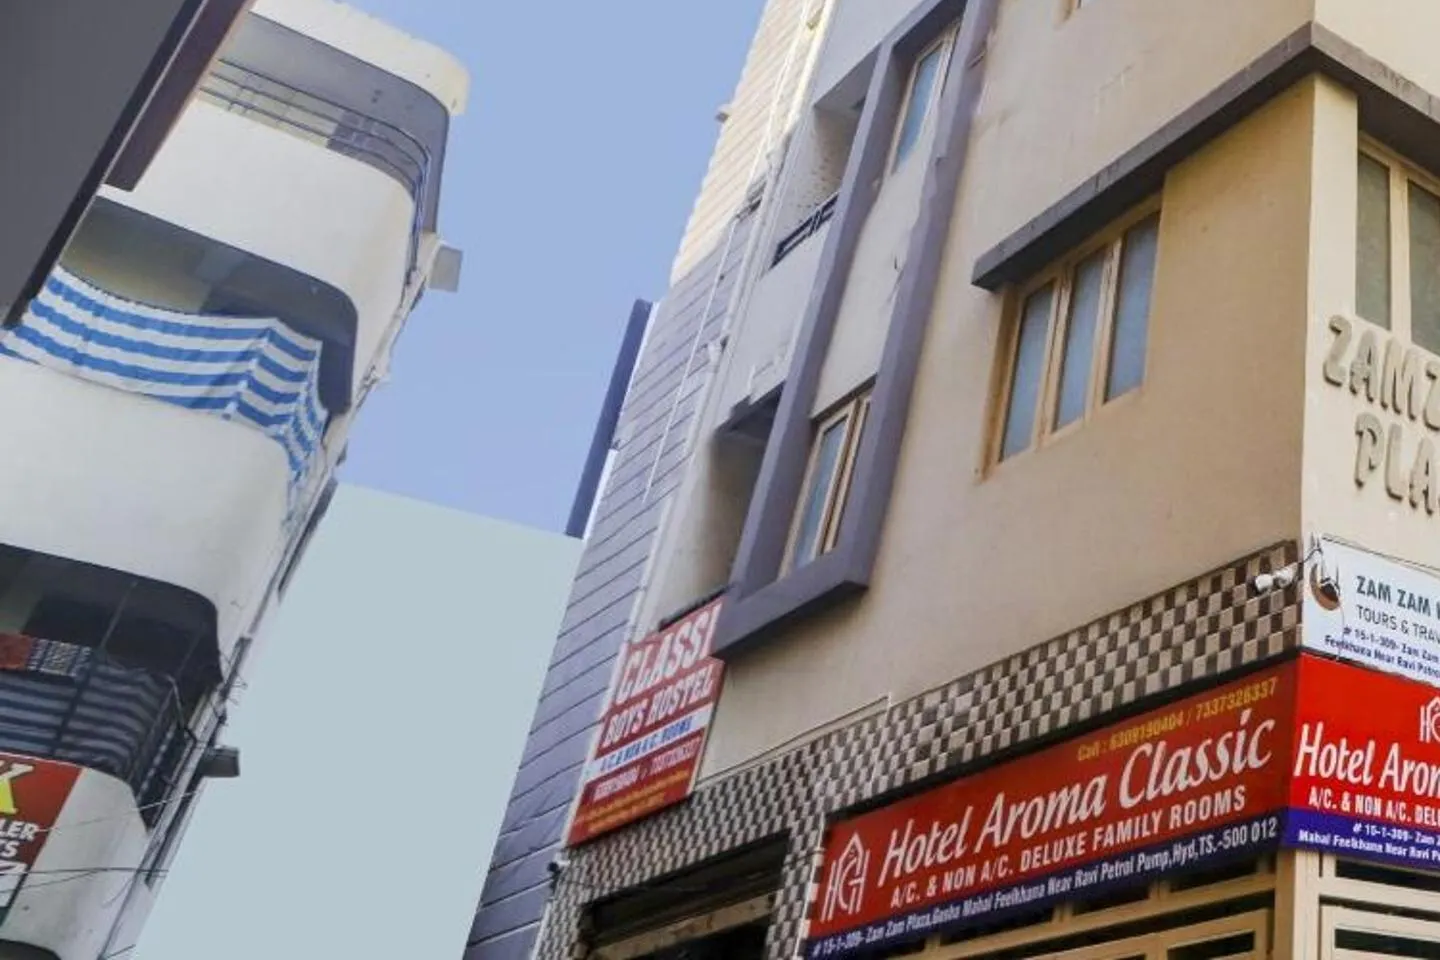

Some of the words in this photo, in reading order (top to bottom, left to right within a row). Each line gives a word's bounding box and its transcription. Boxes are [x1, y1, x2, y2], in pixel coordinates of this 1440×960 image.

[1355, 605, 1397, 632] TOURS
[1356, 575, 1392, 604] ZAM
[1396, 588, 1431, 620] ZAM
[616, 602, 723, 706] CLASSI
[1294, 722, 1376, 786] Hotel
[877, 806, 974, 888] Hotel
[974, 775, 1107, 854] Aroma
[1118, 708, 1276, 809] Classic
[1341, 792, 1351, 812] &
[1355, 794, 1382, 818] NON
[926, 877, 938, 896] &
[943, 867, 975, 894] NON
[1020, 831, 1087, 873] DELUXE
[1092, 809, 1162, 852] FAMILY
[1169, 784, 1246, 830] ROOMS
[1047, 876, 1073, 896] Near
[1074, 864, 1100, 889] Ravi
[1100, 855, 1135, 882] Petrol
[1251, 816, 1278, 841] 012
[1385, 842, 1407, 857] Near
[1415, 831, 1435, 846] Zam
